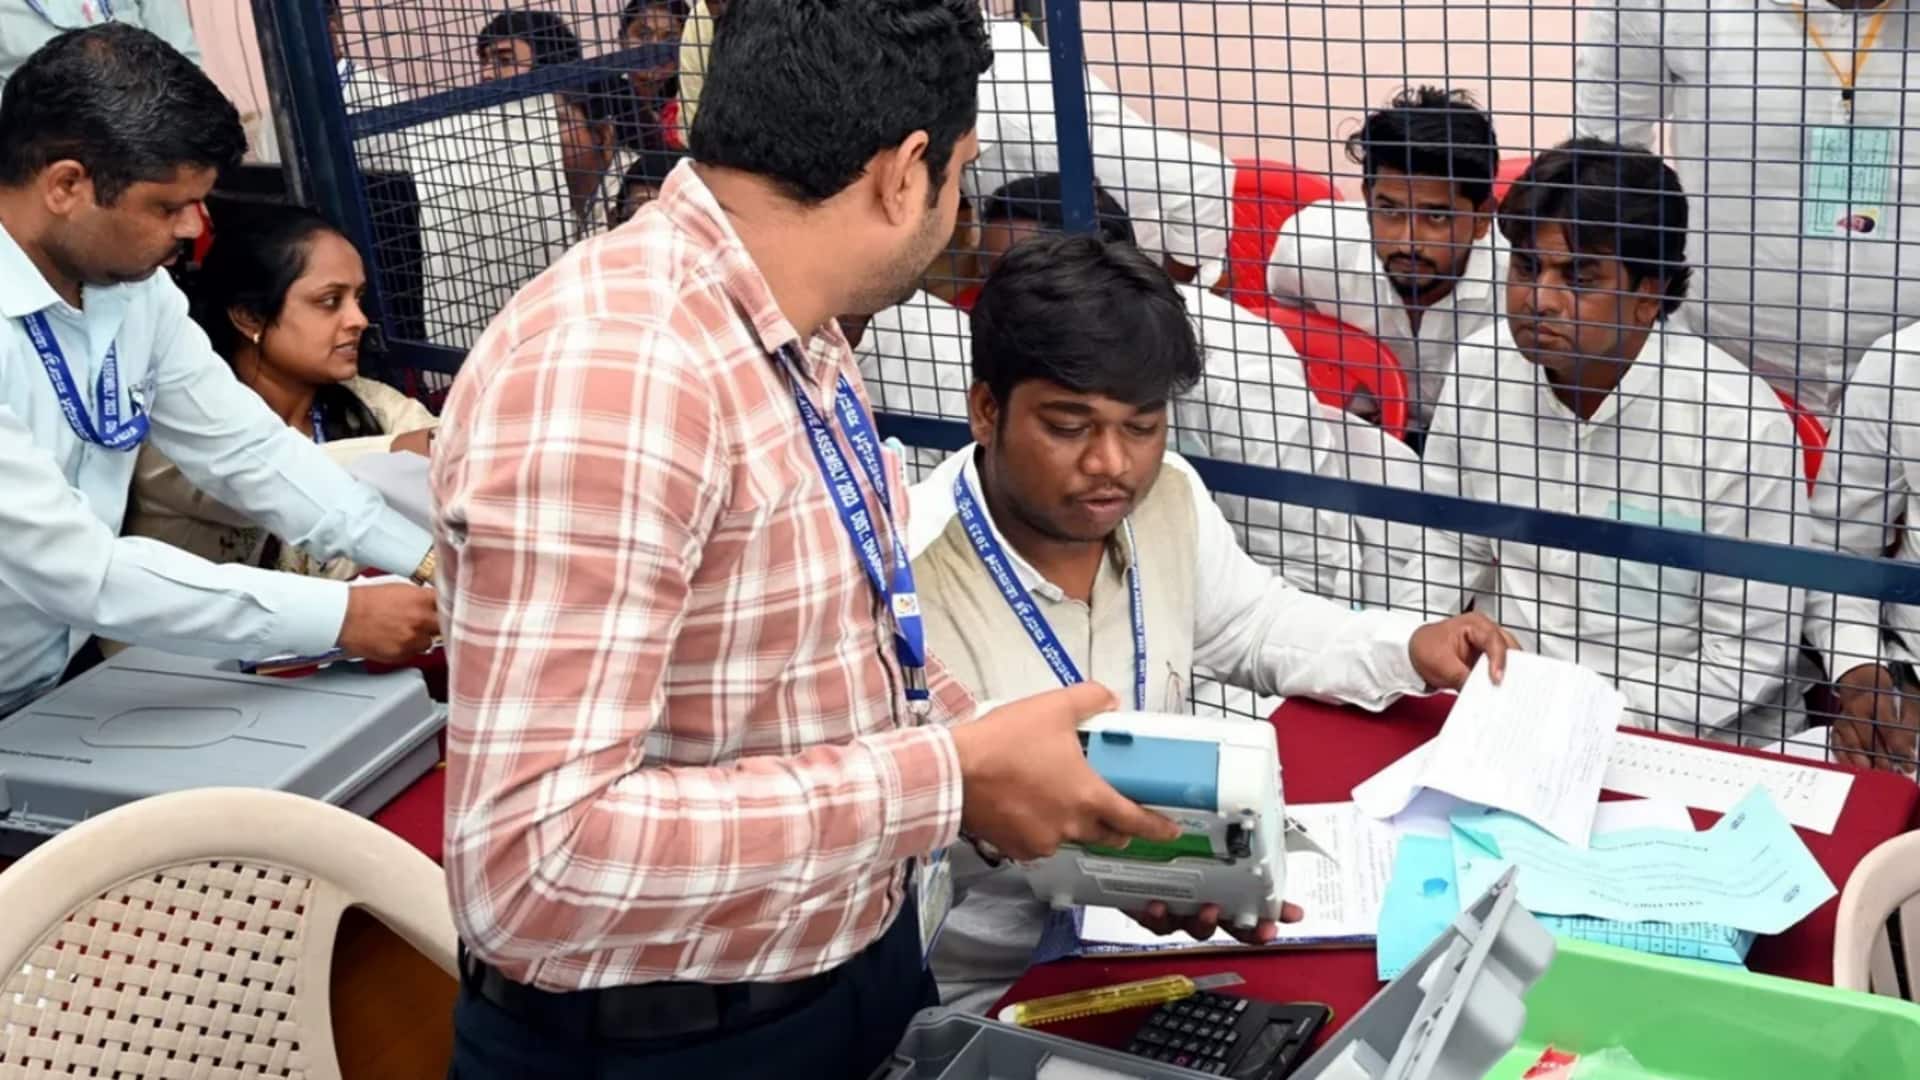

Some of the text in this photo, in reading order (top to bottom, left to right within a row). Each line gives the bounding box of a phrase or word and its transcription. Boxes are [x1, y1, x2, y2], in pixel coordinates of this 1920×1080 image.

[812, 427, 851, 482] ASSEMBLY
[836, 480, 861, 508] 2023
[968, 522, 991, 552] 2023
